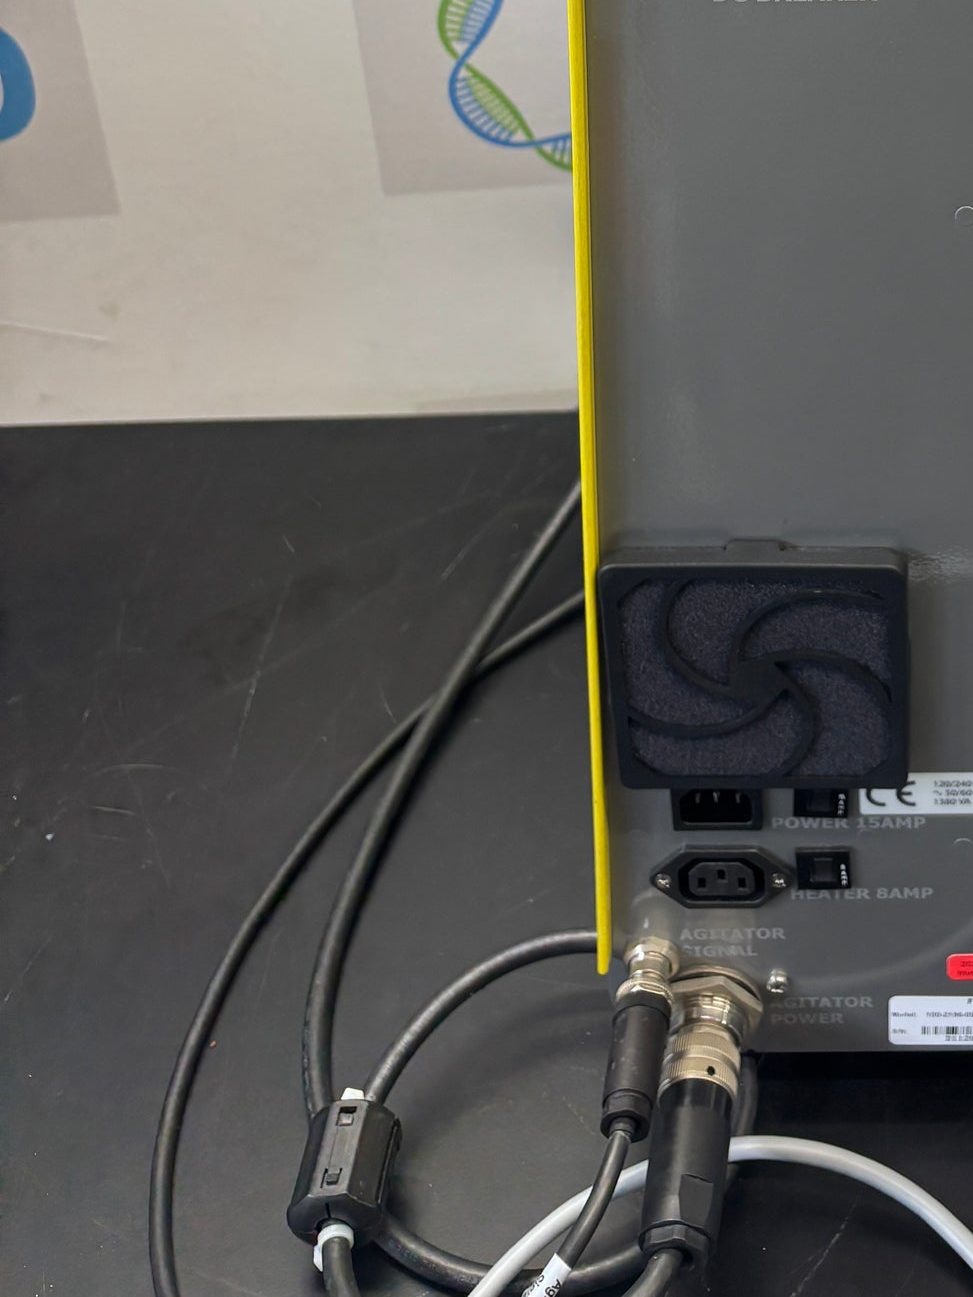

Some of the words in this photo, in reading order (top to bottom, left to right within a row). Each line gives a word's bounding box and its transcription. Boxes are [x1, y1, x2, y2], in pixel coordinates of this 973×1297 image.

[771, 817, 849, 829] POWER
[857, 816, 927, 829] 15AMP
[790, 887, 871, 900] HEATER
[876, 887, 934, 900] 8AMP
[679, 927, 786, 941] AGITATOR
[769, 996, 874, 1009] AGITATOR
[770, 1012, 845, 1024] POWER
